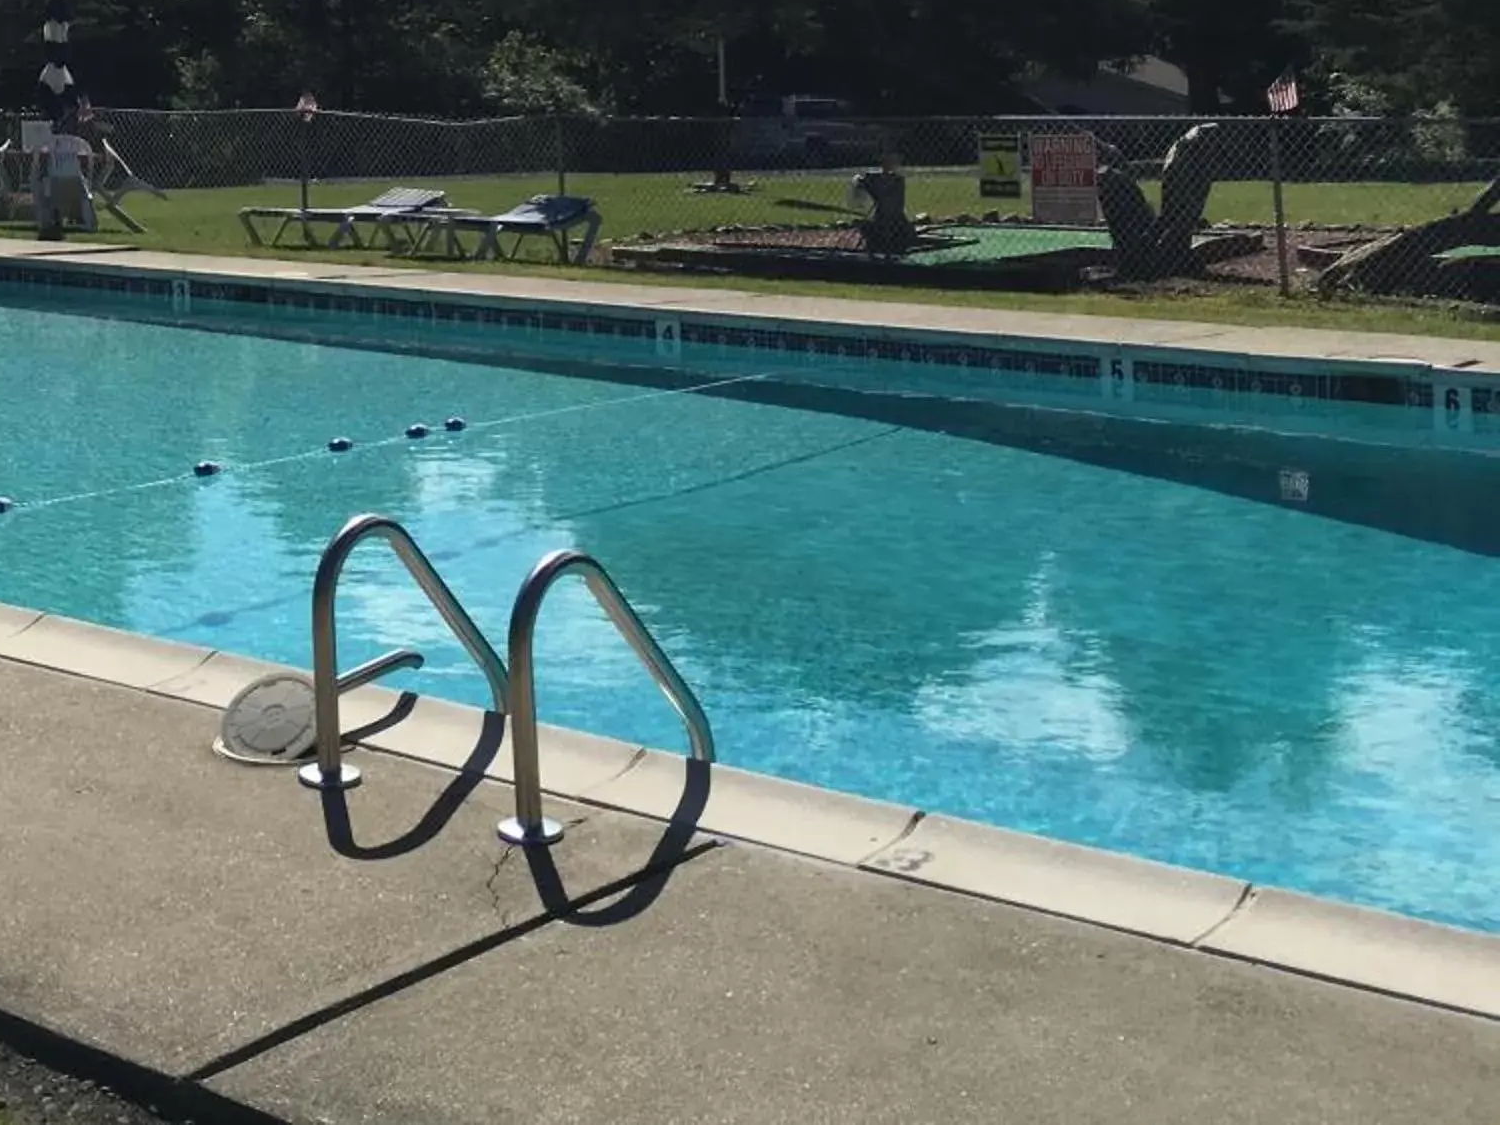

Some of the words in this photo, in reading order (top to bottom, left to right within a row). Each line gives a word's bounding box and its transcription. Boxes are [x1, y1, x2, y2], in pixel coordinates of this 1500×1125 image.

[1032, 138, 1091, 154] WARNING
[662, 324, 674, 340] 4
[1445, 387, 1460, 412] 6
